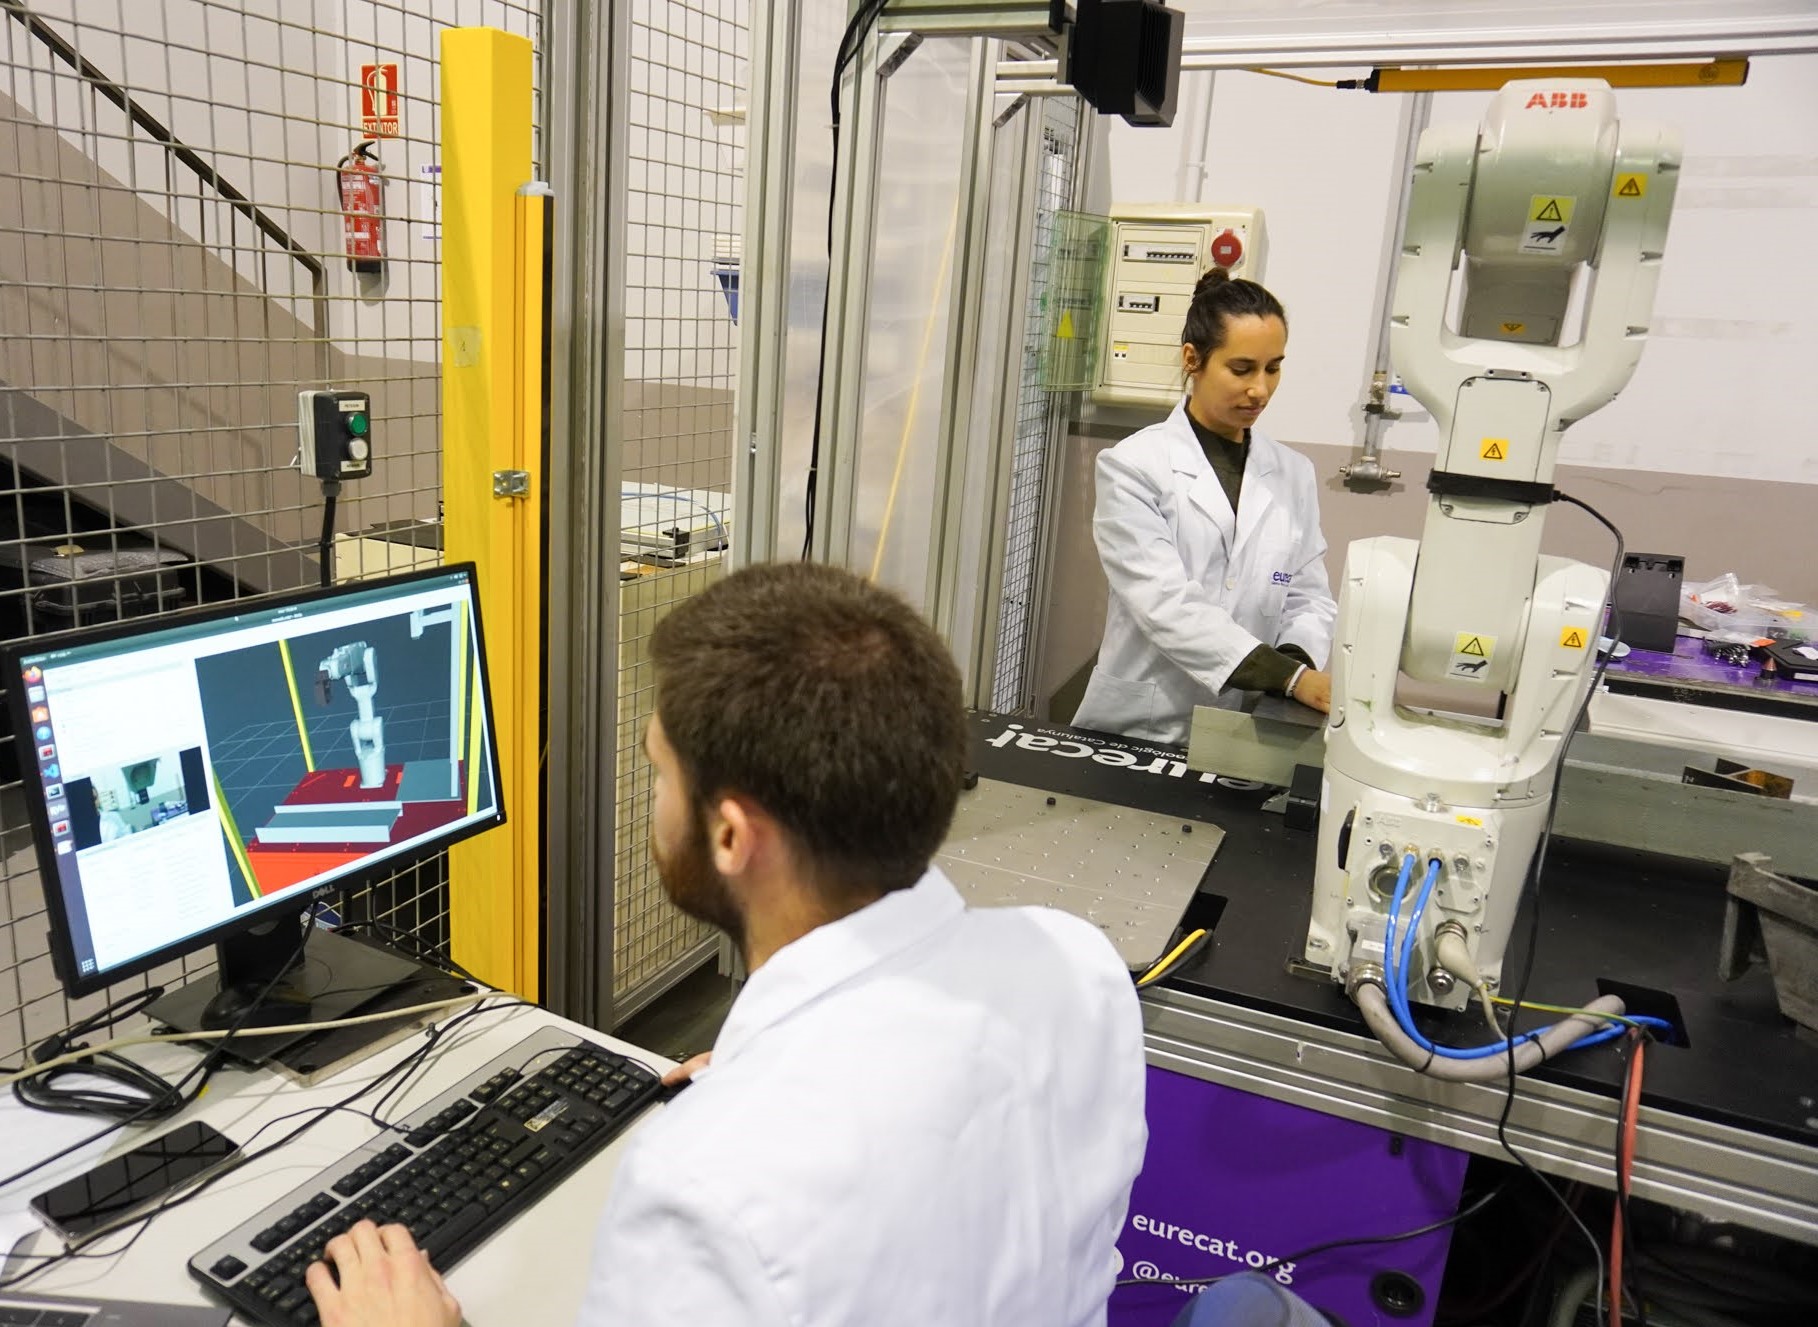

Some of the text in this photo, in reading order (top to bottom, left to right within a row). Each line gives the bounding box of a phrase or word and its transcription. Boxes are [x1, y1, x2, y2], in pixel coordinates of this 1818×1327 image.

[1524, 92, 1588, 109] ABB
[363, 122, 398, 135] EXTNTOR
[1037, 729, 1105, 746] Catalunya
[1132, 1214, 1296, 1285] eurecat.org
